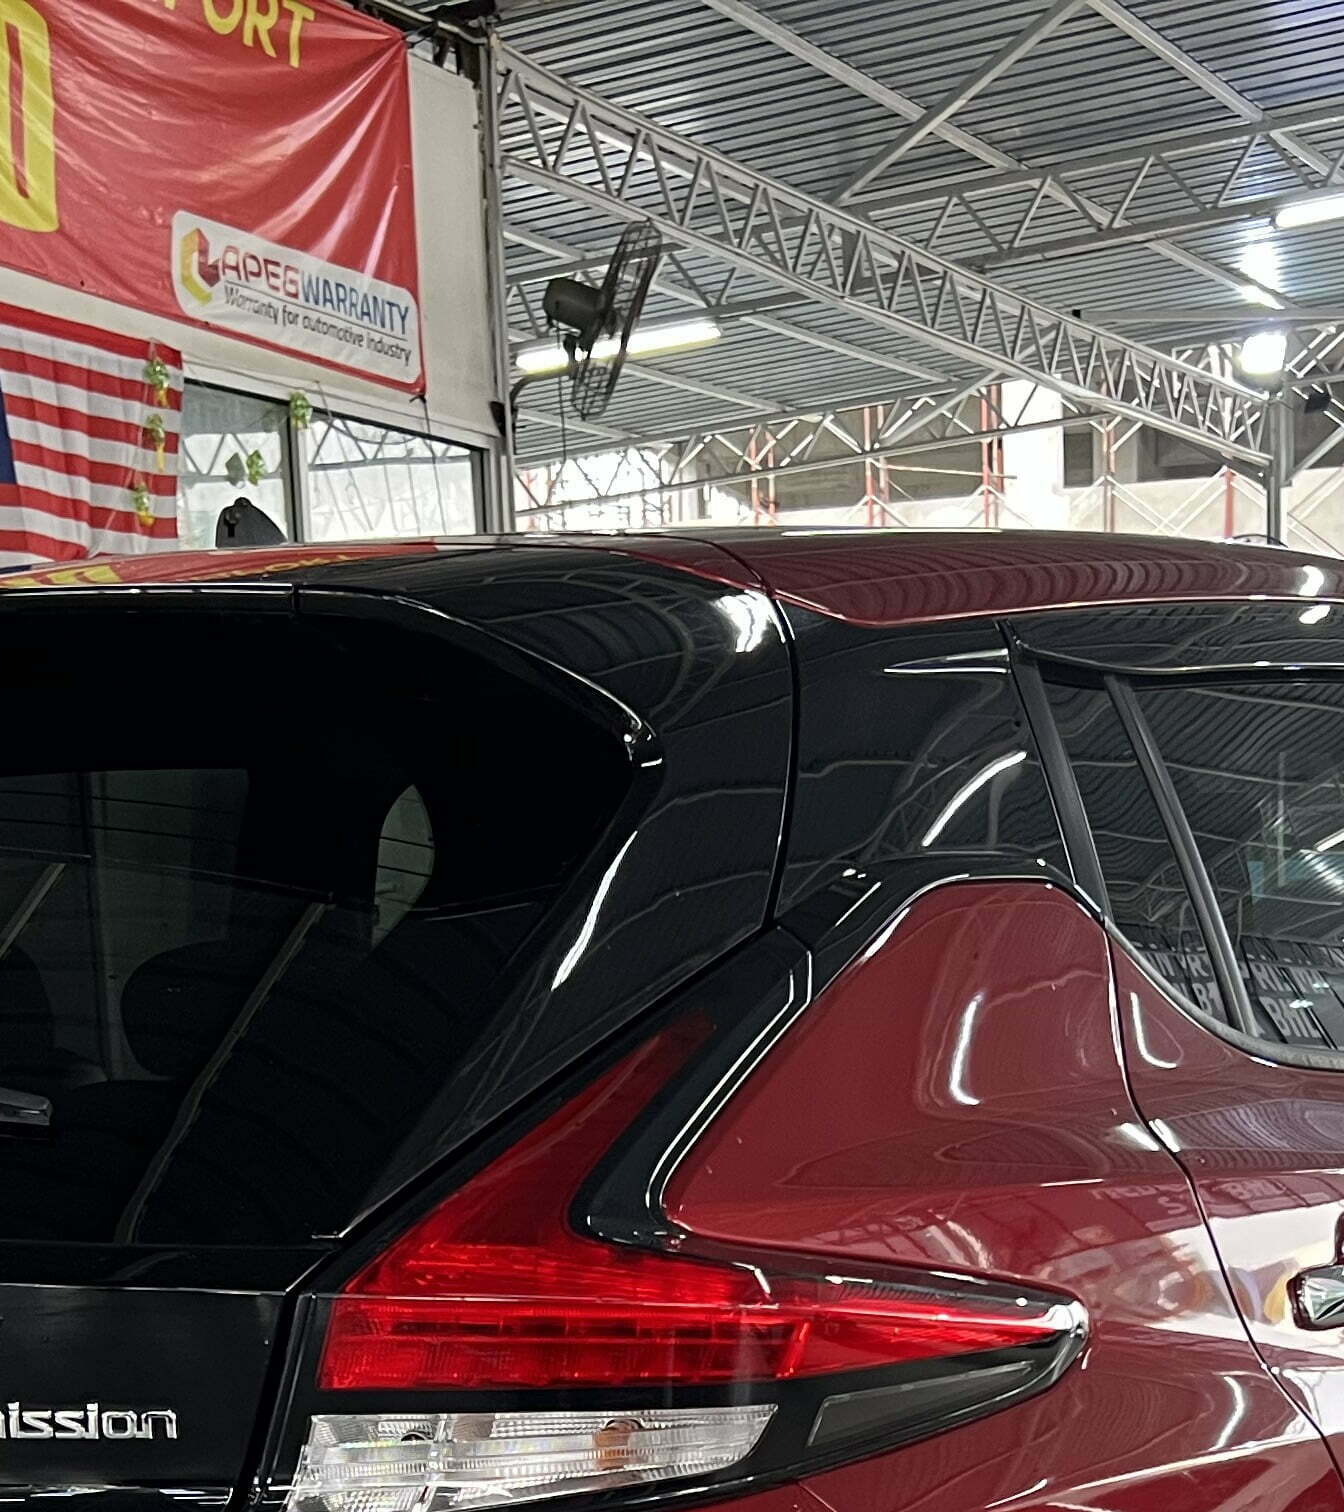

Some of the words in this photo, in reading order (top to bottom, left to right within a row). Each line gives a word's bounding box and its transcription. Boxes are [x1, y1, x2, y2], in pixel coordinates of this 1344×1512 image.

[224, 285, 279, 325] Warranty
[282, 303, 300, 327] for
[302, 314, 365, 348] automotive
